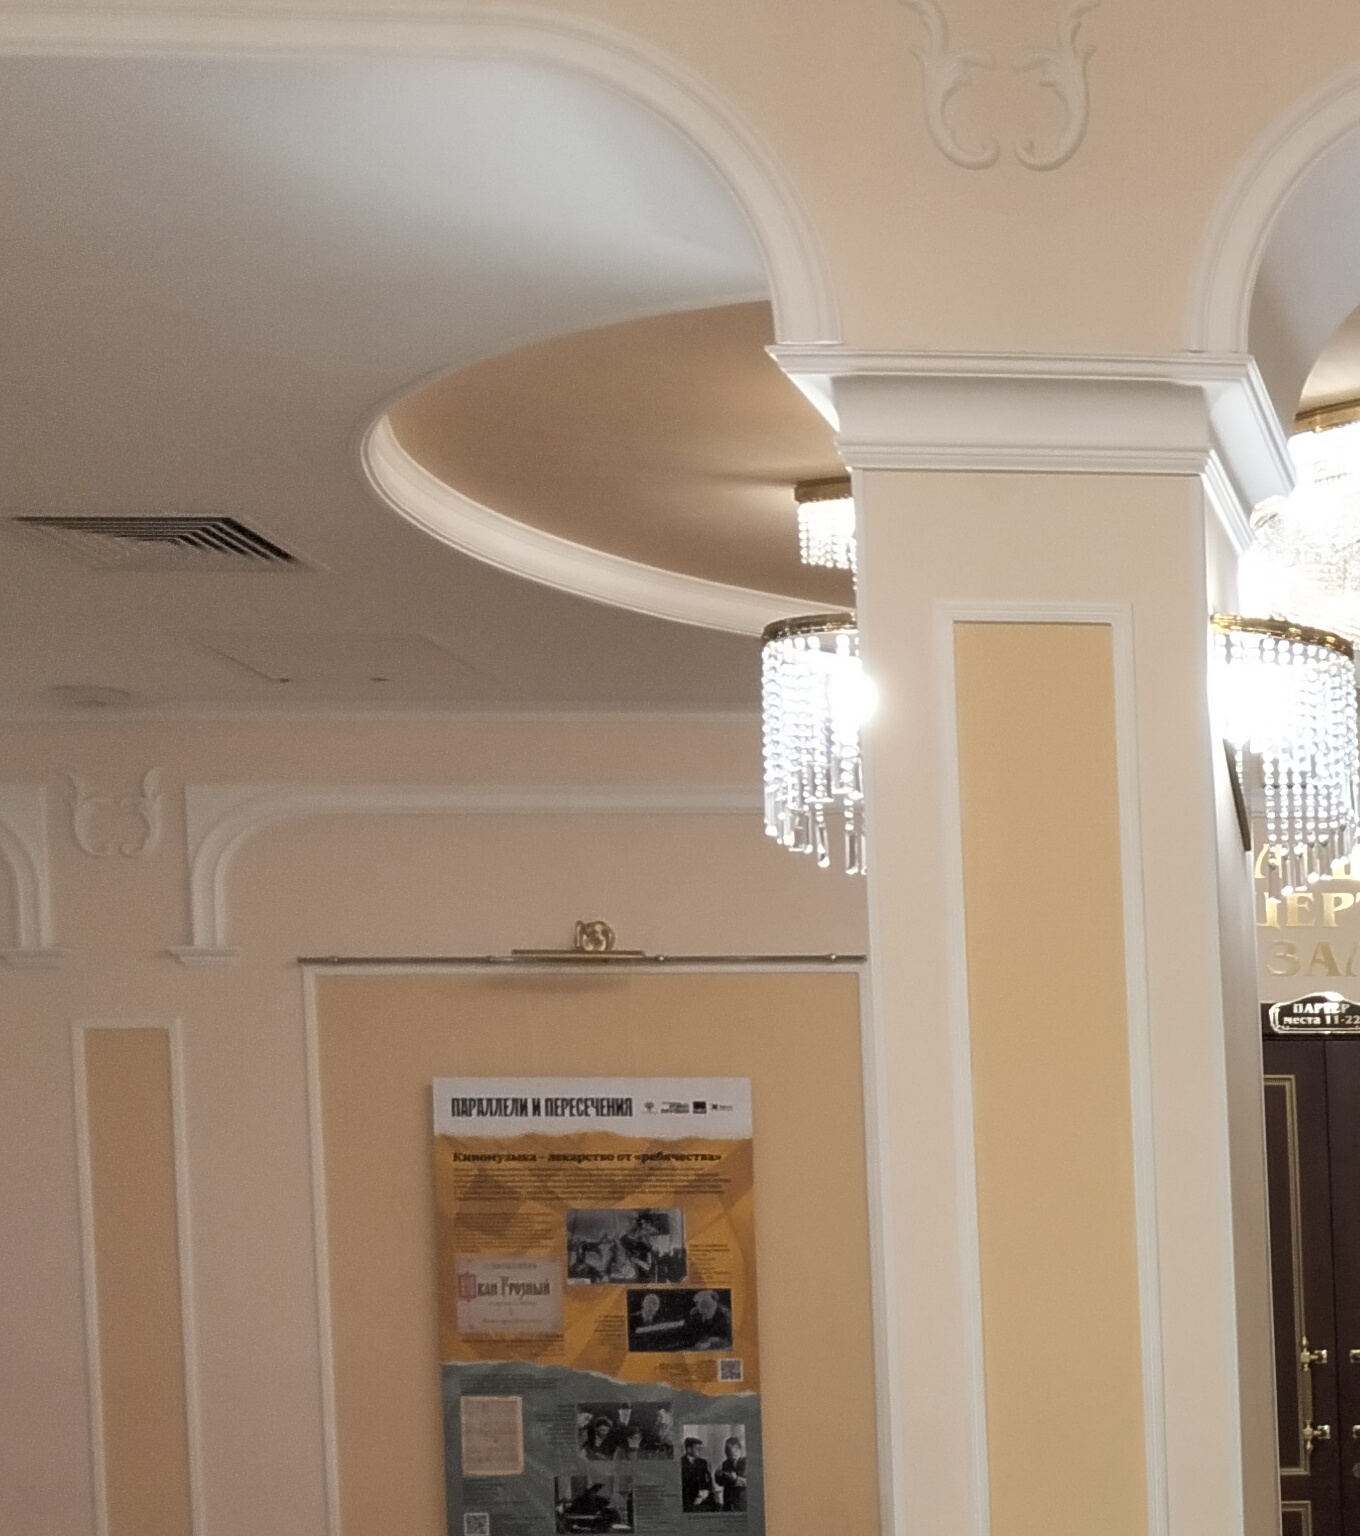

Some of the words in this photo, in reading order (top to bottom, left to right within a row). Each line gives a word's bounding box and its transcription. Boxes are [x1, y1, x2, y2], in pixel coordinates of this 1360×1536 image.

[1283, 1016, 1321, 1025] места
[451, 1097, 528, 1117] ПАРАЛЛЕЛИ
[532, 1097, 541, 1117] И
[545, 1097, 633, 1117] ПЕРЕСЕЧЕНИЯ
[548, 1153, 614, 1164] лекарство
[616, 1153, 632, 1161] от
